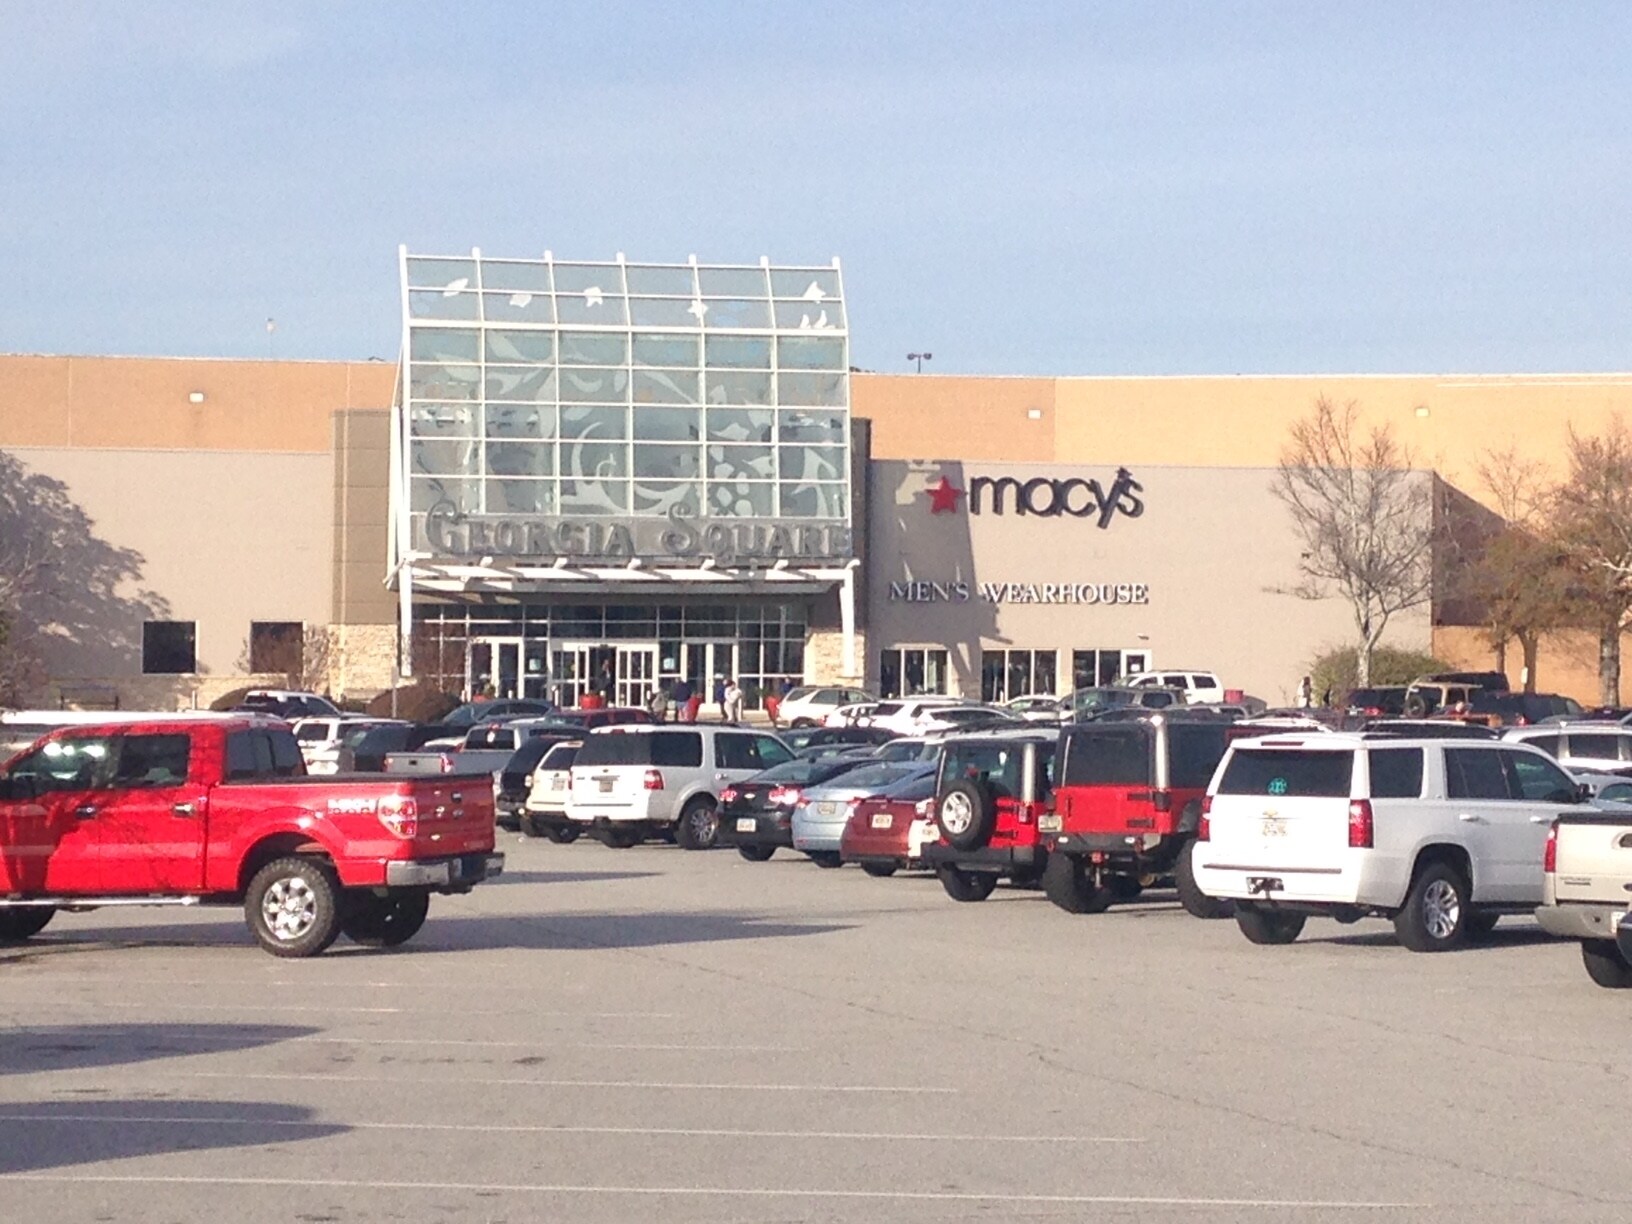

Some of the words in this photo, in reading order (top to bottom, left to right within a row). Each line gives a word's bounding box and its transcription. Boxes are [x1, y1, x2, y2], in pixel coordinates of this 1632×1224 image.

[970, 467, 1144, 529] macy's
[426, 499, 635, 556] GEORGIA
[659, 502, 853, 566] SQUARE
[891, 581, 969, 601] MEN'S
[980, 582, 1149, 604] WEARHOUSE
